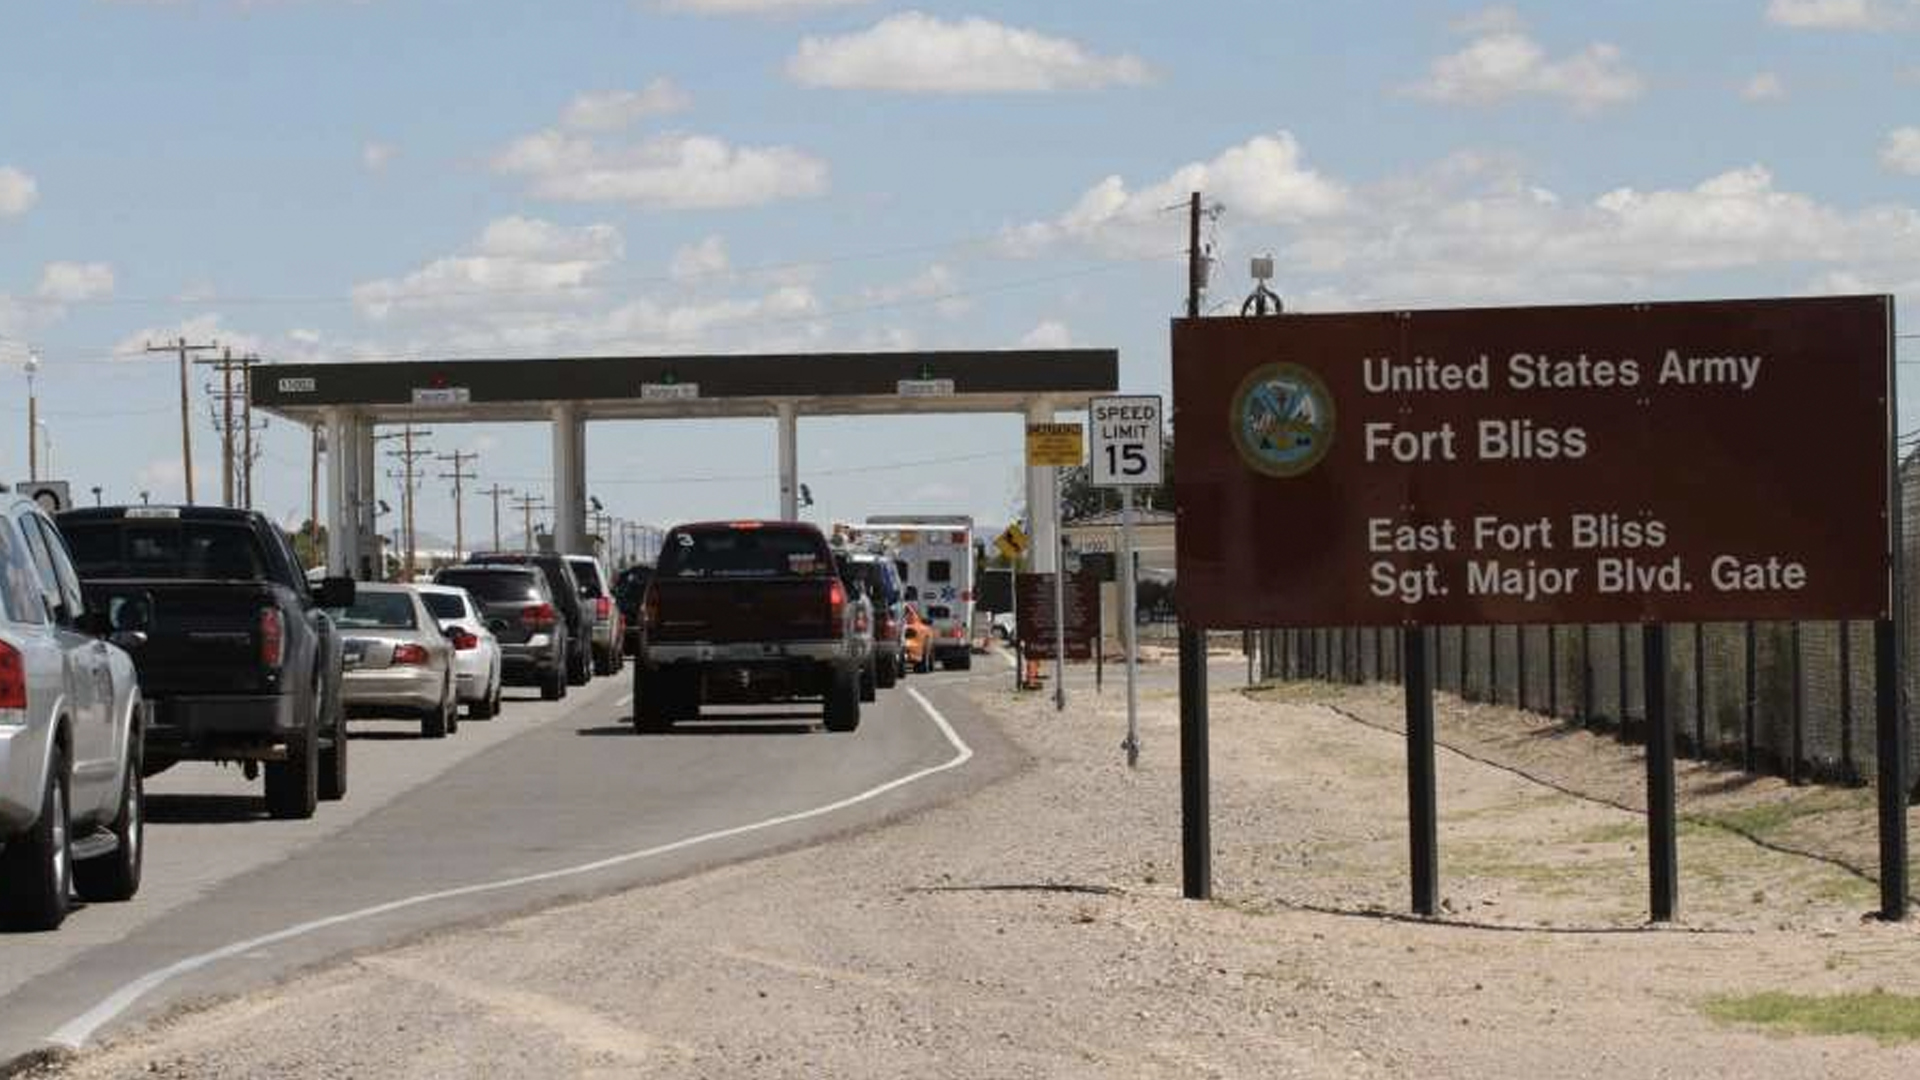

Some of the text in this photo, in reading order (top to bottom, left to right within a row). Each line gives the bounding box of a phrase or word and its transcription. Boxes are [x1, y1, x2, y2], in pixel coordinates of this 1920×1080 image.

[1363, 350, 1761, 392] United States Army
[1097, 405, 1154, 419] SPEED
[1103, 424, 1150, 438] LIMIT
[1105, 443, 1148, 476] 15
[1365, 419, 1587, 462] Fort Bliss
[1368, 513, 1666, 552] East Fort Bliss
[1370, 555, 1806, 604] Sgt. Major Blvd. Gate
